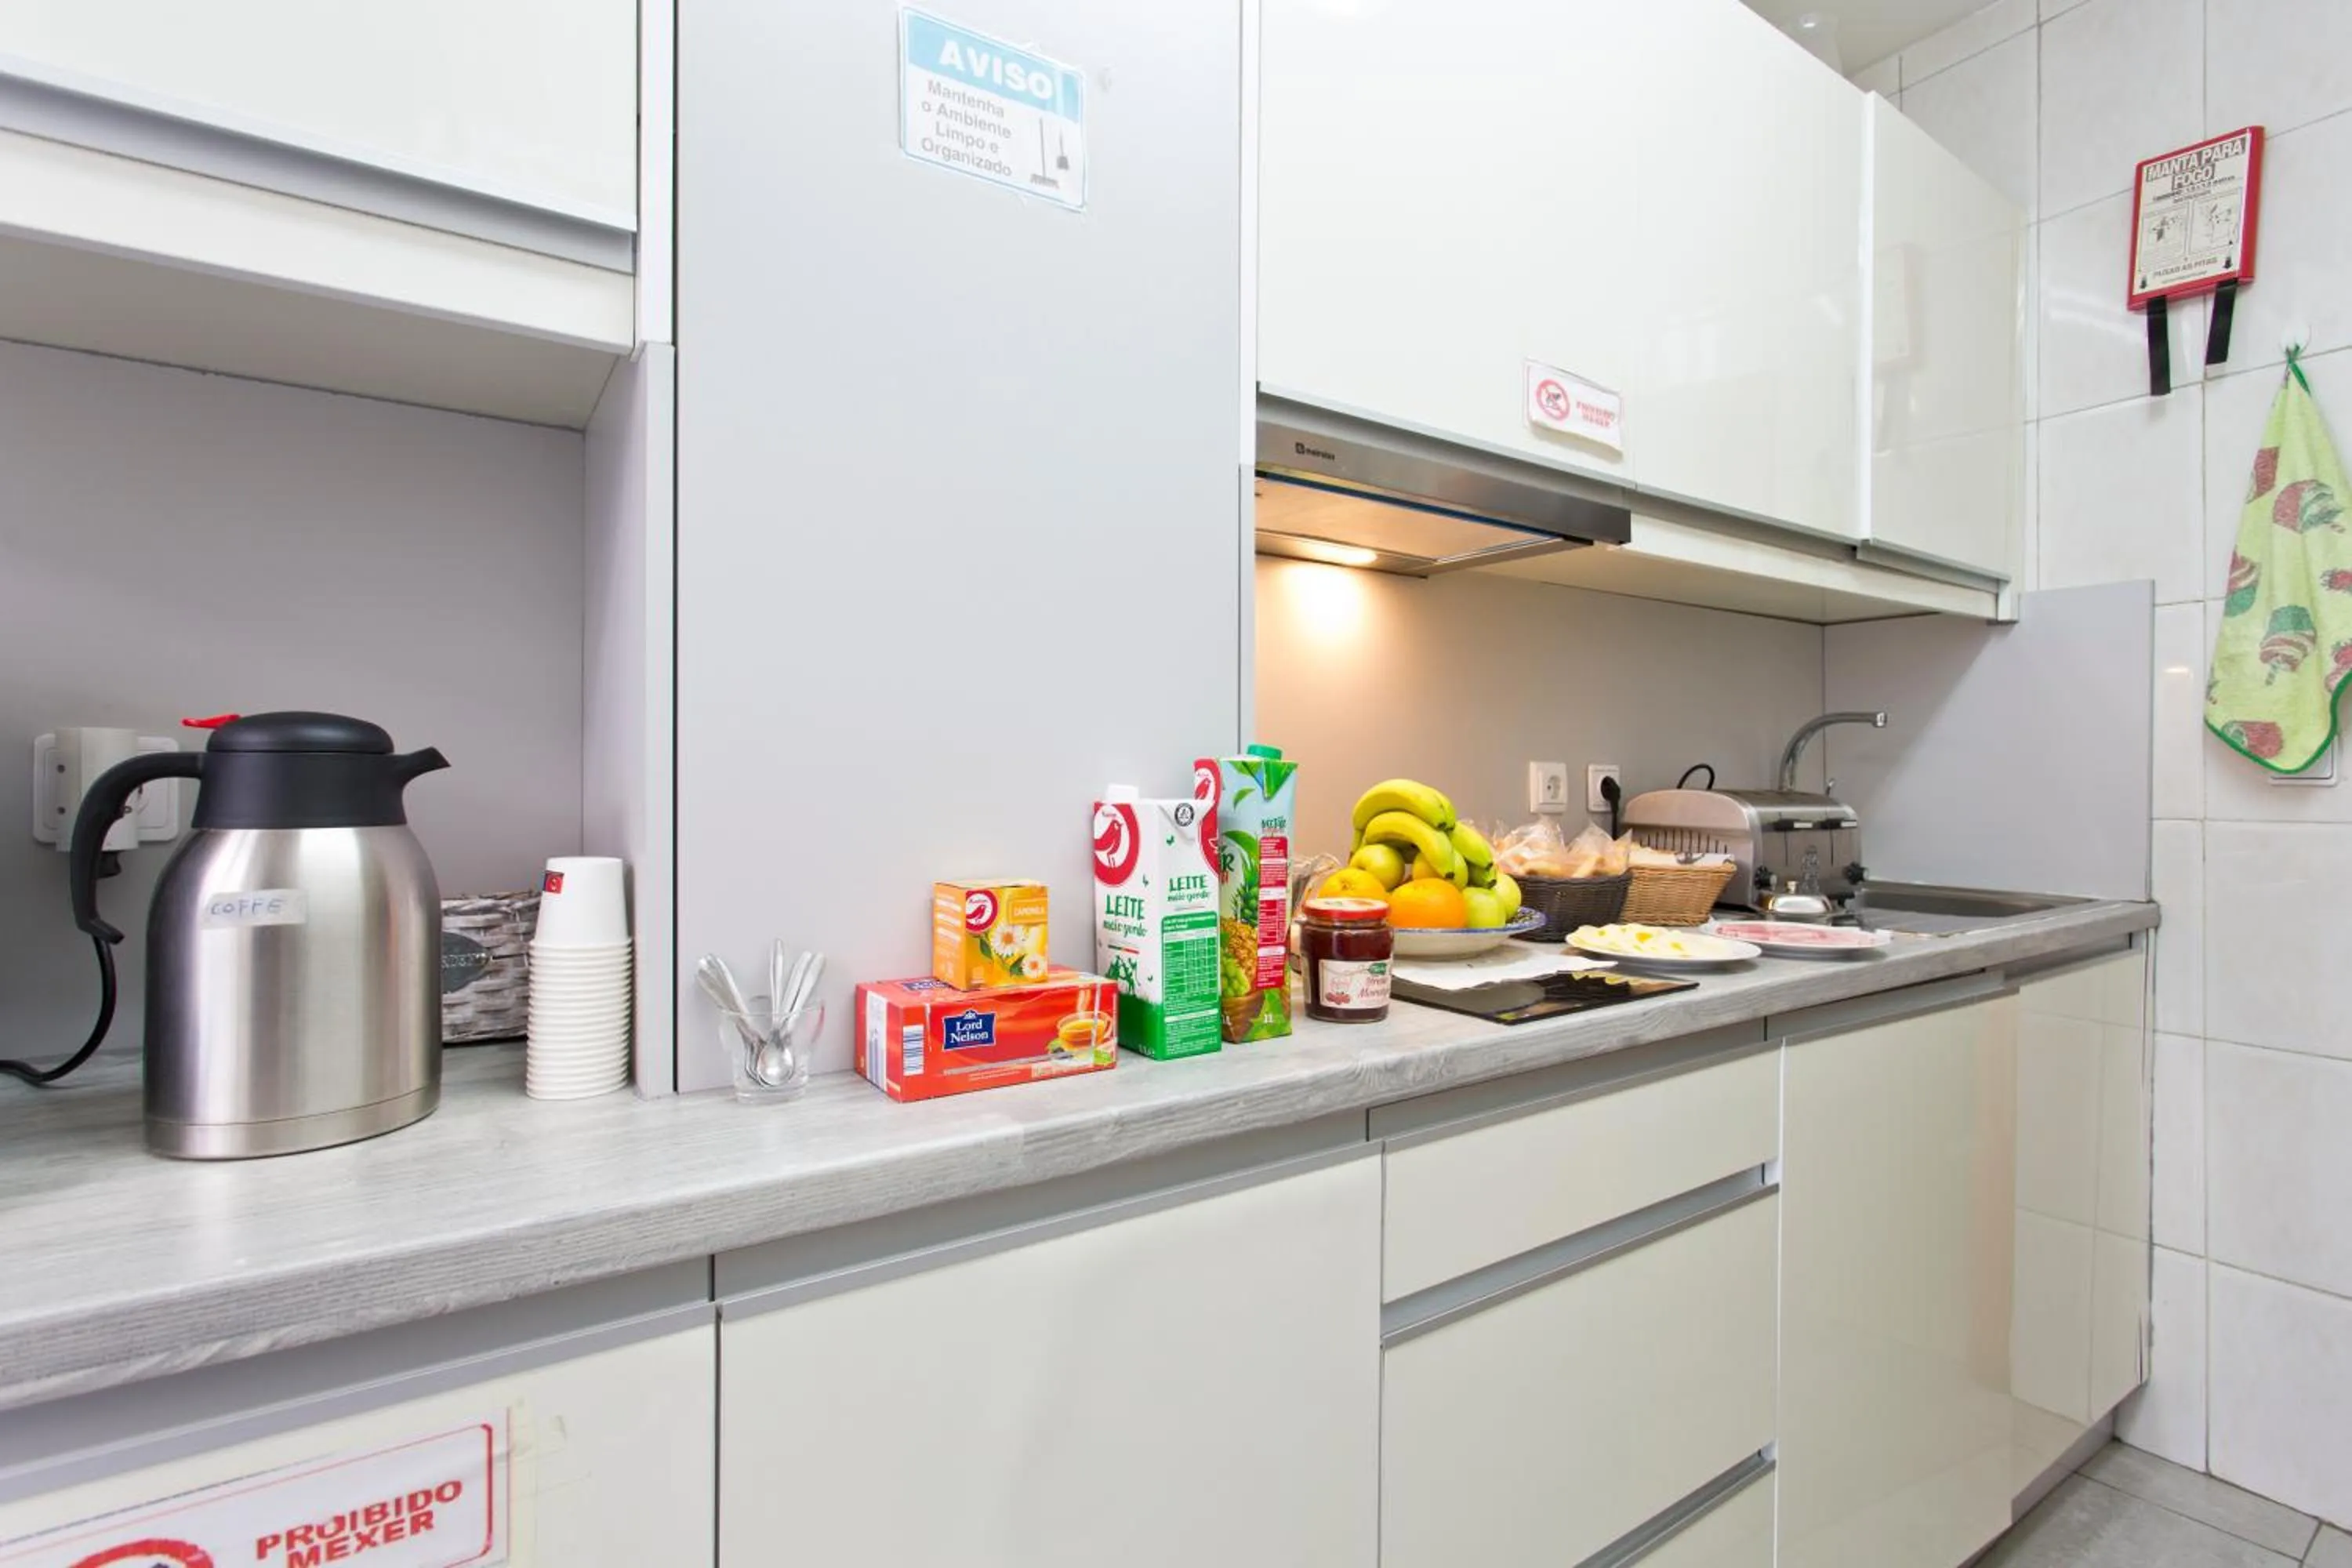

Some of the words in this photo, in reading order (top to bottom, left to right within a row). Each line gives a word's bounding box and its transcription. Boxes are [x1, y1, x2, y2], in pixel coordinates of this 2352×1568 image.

[938, 39, 1054, 100] AVISO
[927, 79, 1005, 118] Mantenha
[921, 100, 931, 113] o
[936, 103, 1012, 140] Ambiente
[935, 121, 985, 150] Limpo
[990, 141, 1000, 154] e
[920, 137, 1013, 177] Organizado
[2147, 153, 2200, 182] MANTA
[2201, 140, 2243, 165] PARA
[2173, 163, 2213, 189] FOGO
[1169, 874, 1208, 891] LEITE
[210, 898, 287, 918] COFFE
[1105, 893, 1145, 920] LEITE
[949, 1031, 989, 1044] Nelson
[956, 1018, 983, 1032] Lord
[255, 1479, 463, 1560] PROIBIDO
[287, 1509, 434, 1568] MEXER
